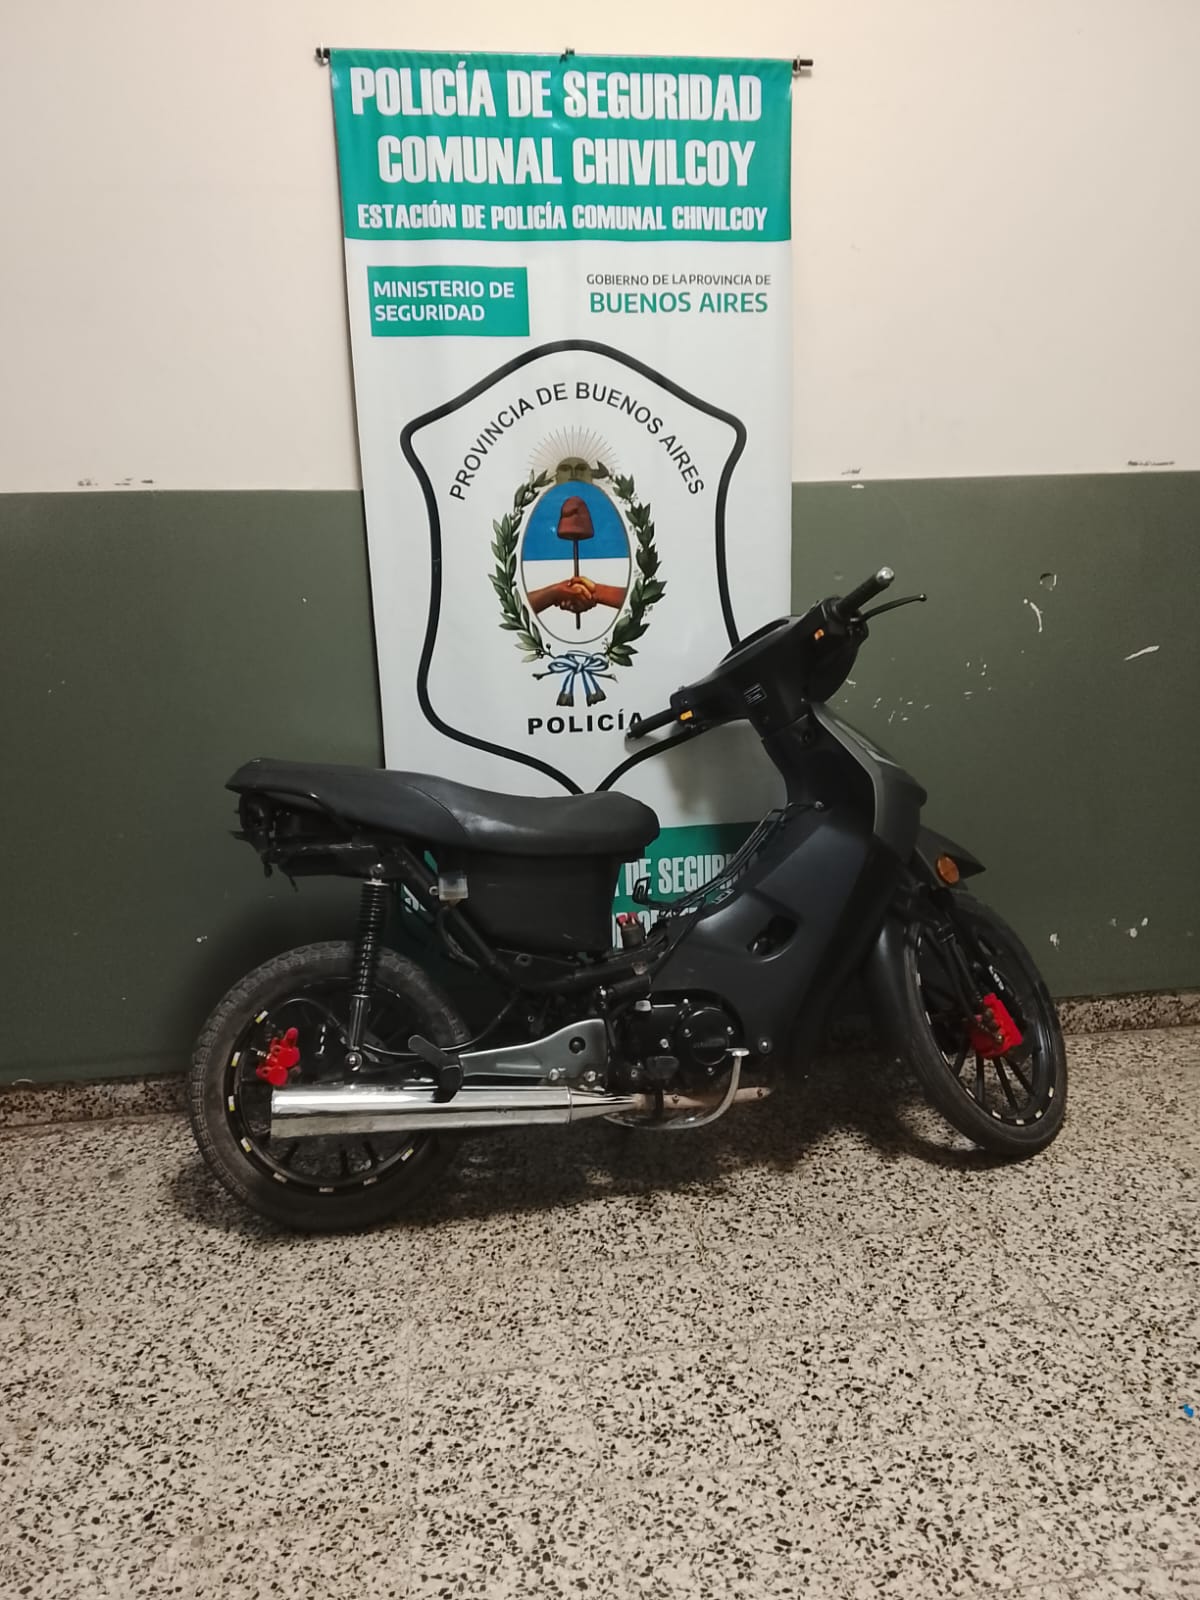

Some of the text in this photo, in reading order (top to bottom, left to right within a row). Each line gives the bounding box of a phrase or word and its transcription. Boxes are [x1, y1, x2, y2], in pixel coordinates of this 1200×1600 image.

[350, 61, 762, 121] POLICÍA DE SEGURIDAD
[377, 135, 756, 187] COMUNAL CHIVILCOY
[357, 201, 768, 231] ESTACIÓN DE POLICÍA COMUNAL CHIVILCOY
[373, 280, 515, 298] MINISTERIO DE
[586, 273, 771, 285] GOBIERNO DE LA PROVINCIA DE
[374, 304, 485, 321] SEGURIDAD
[590, 292, 768, 314] BUENOS AIRES
[449, 381, 705, 501] PROVINCIA DE BUENOS AIRES
